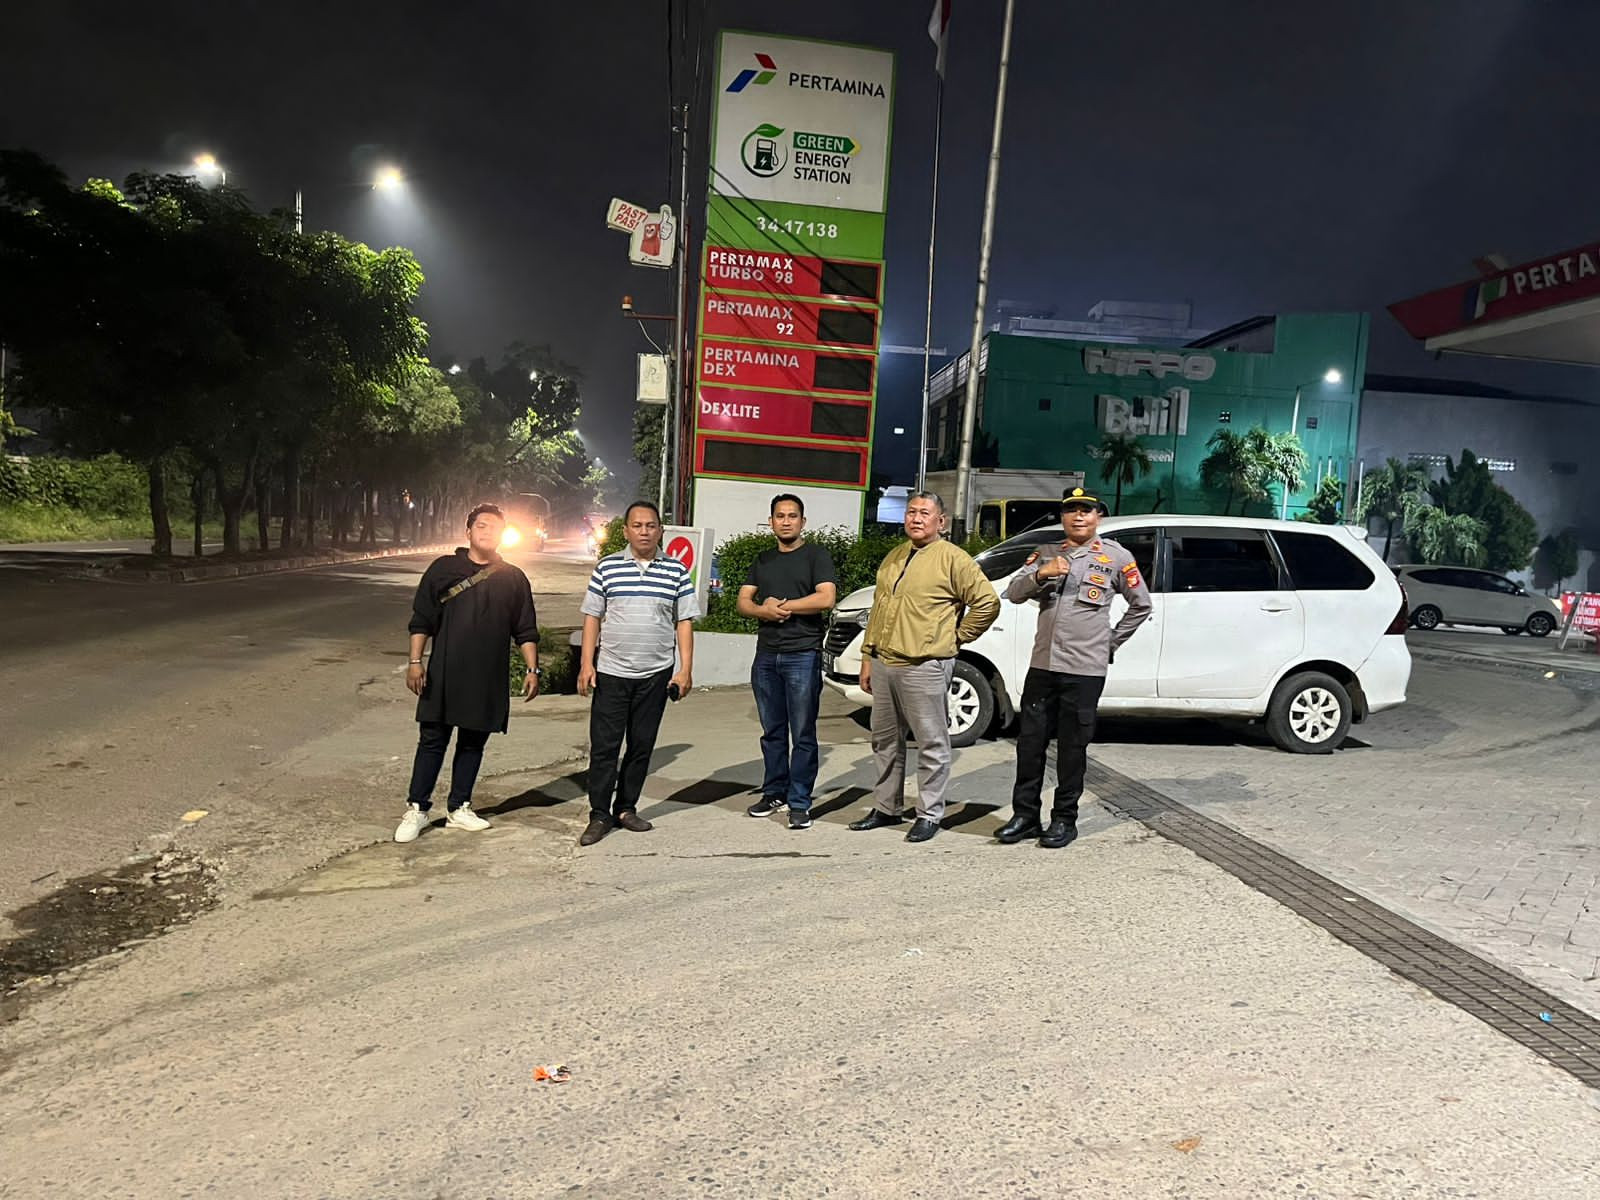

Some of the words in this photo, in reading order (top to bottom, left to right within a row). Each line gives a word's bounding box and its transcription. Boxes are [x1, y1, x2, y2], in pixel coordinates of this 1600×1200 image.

[789, 73, 885, 98] PERTAMINA
[796, 134, 845, 150] GREEN
[795, 152, 849, 168] ENERGY
[794, 168, 851, 184] STATION
[757, 216, 838, 238] 34.17138
[710, 252, 793, 270] PERTAMAX
[710, 264, 764, 281] TURBO
[775, 271, 794, 284] 98
[1513, 248, 1600, 294] PERTA
[708, 300, 793, 320] PERTAMAX
[776, 323, 794, 335] 92
[705, 348, 799, 368] PERTAMINA
[704, 363, 736, 377] DEX
[702, 402, 760, 419] DEXLITE
[1088, 564, 1112, 575] POLRI
